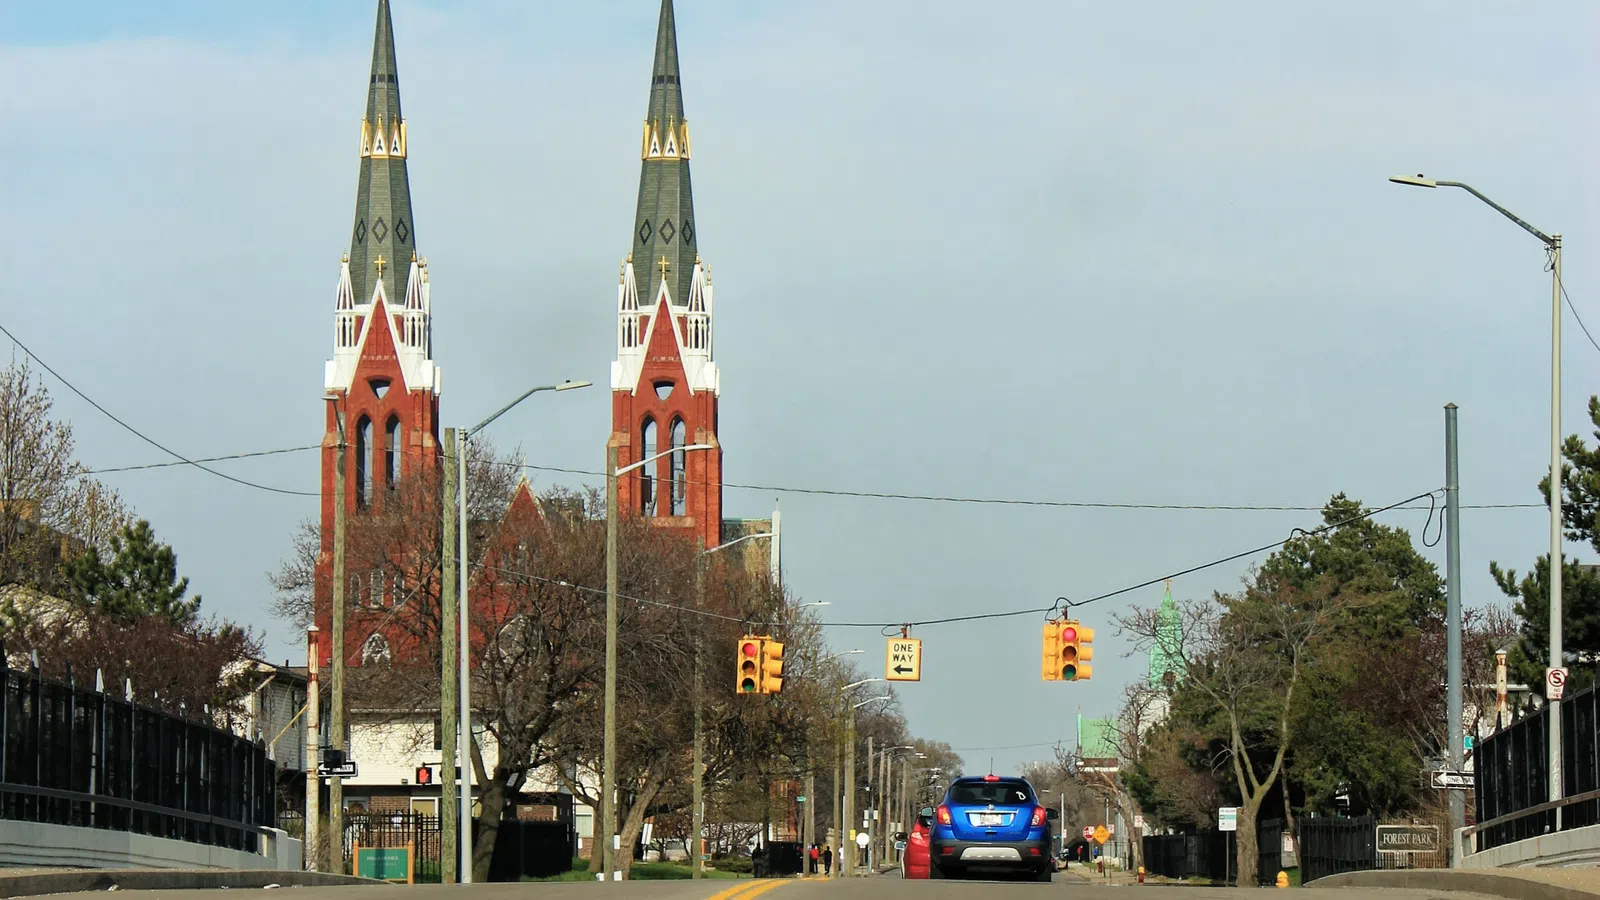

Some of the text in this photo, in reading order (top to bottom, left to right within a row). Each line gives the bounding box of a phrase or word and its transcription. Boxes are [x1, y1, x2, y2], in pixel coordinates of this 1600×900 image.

[893, 643, 913, 652] ONE
[893, 654, 913, 662] WAY
[1447, 776, 1460, 784] ONE
[1383, 833, 1432, 845] FOREST PARK
